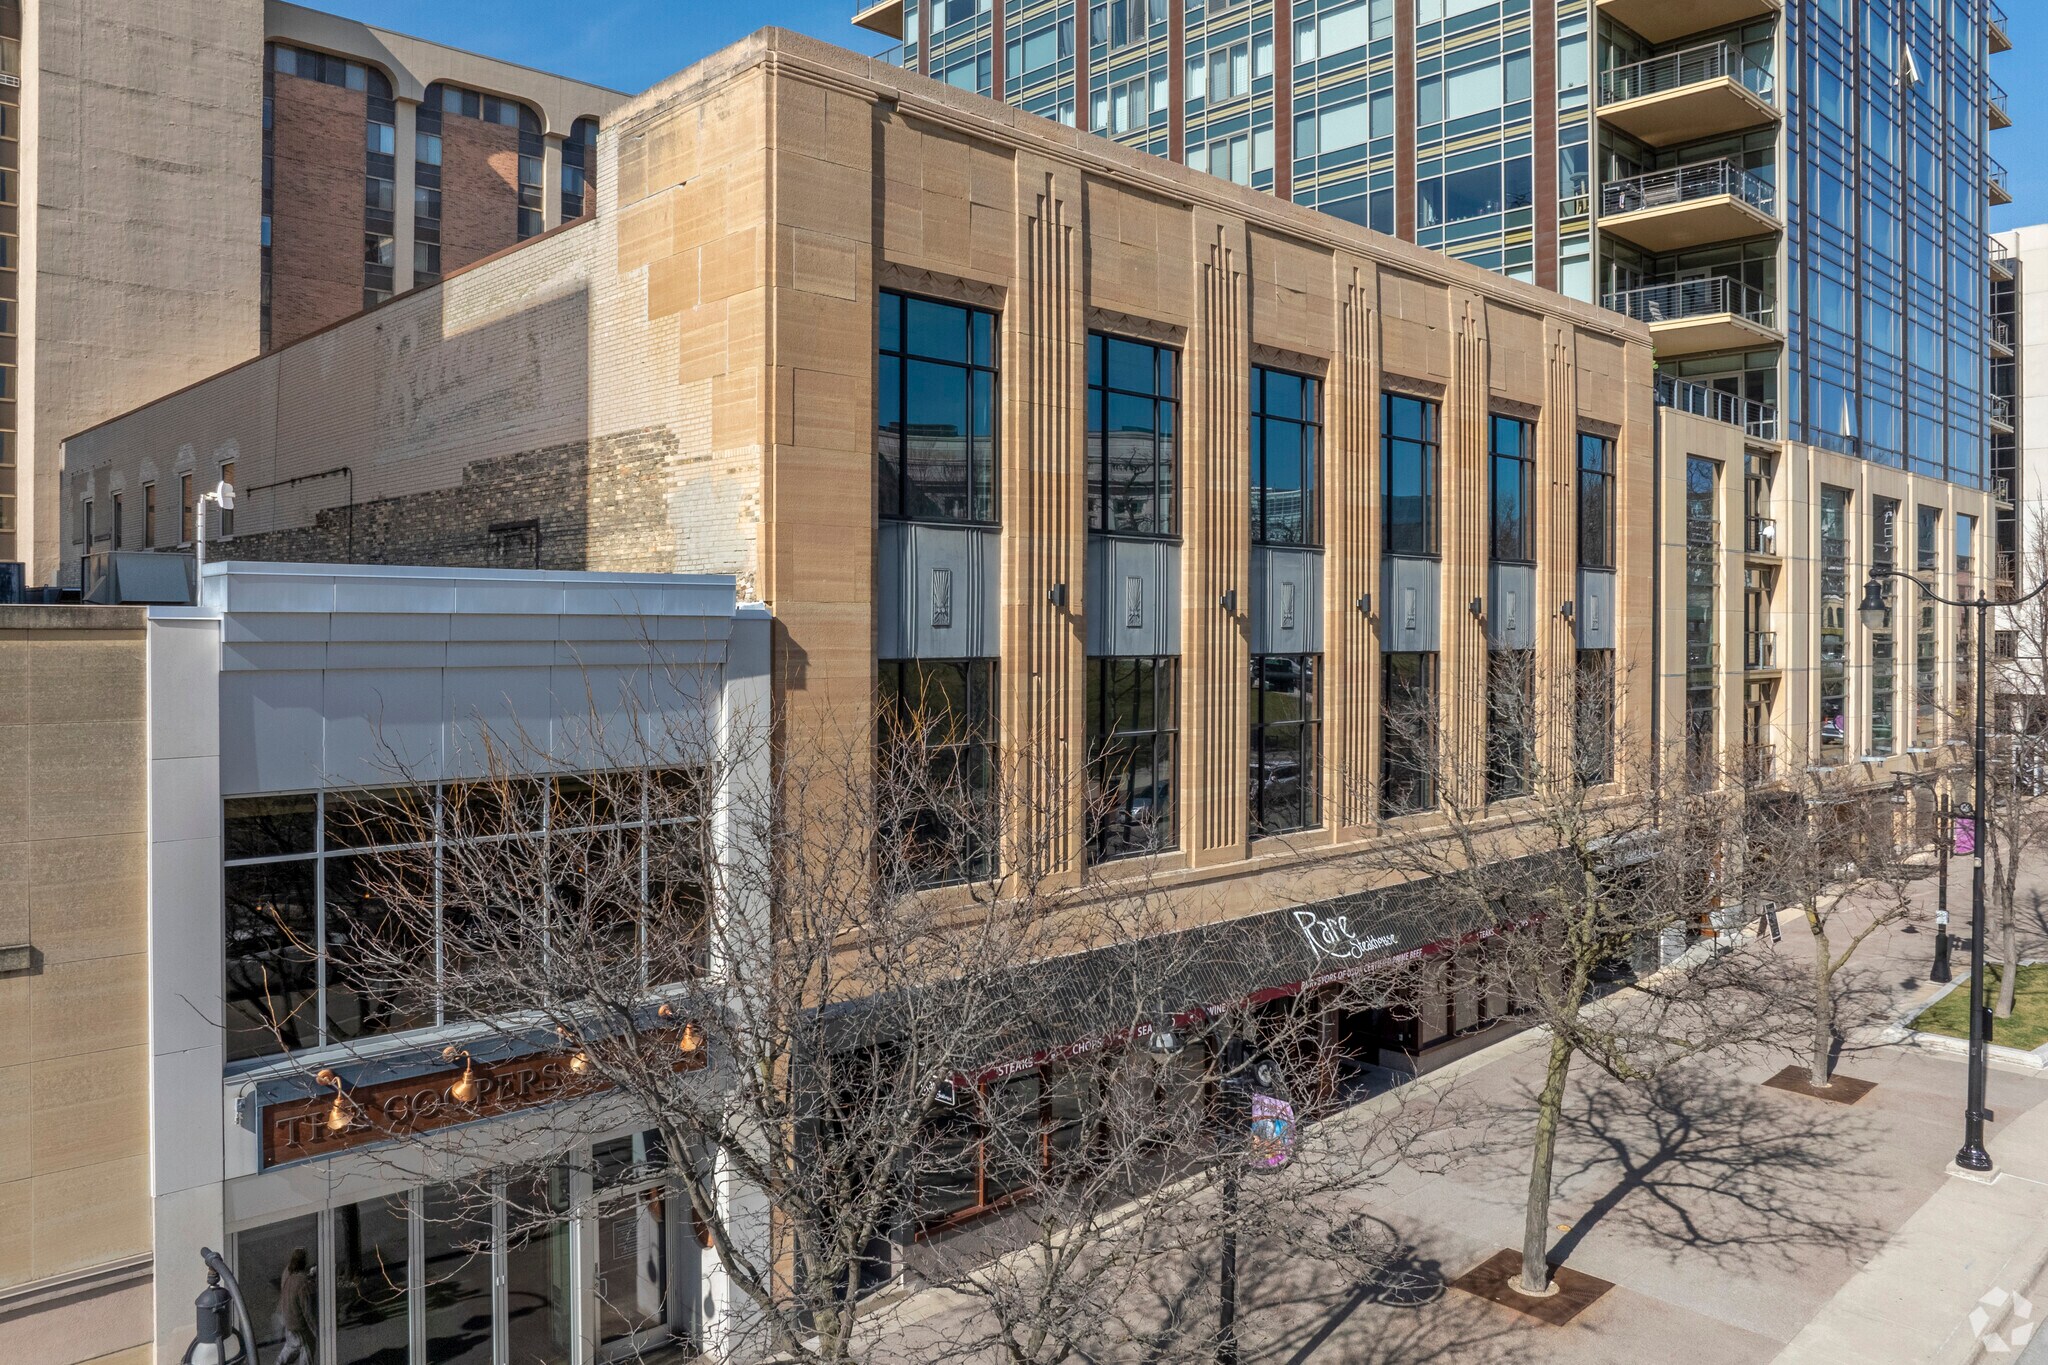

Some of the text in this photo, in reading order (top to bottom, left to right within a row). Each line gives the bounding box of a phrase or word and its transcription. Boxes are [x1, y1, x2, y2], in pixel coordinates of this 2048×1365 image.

[1293, 911, 1355, 961] Rare
[1349, 933, 1398, 958] Steakhouse
[1410, 948, 1423, 960] BEEF
[998, 1057, 1034, 1076] STEAKS
